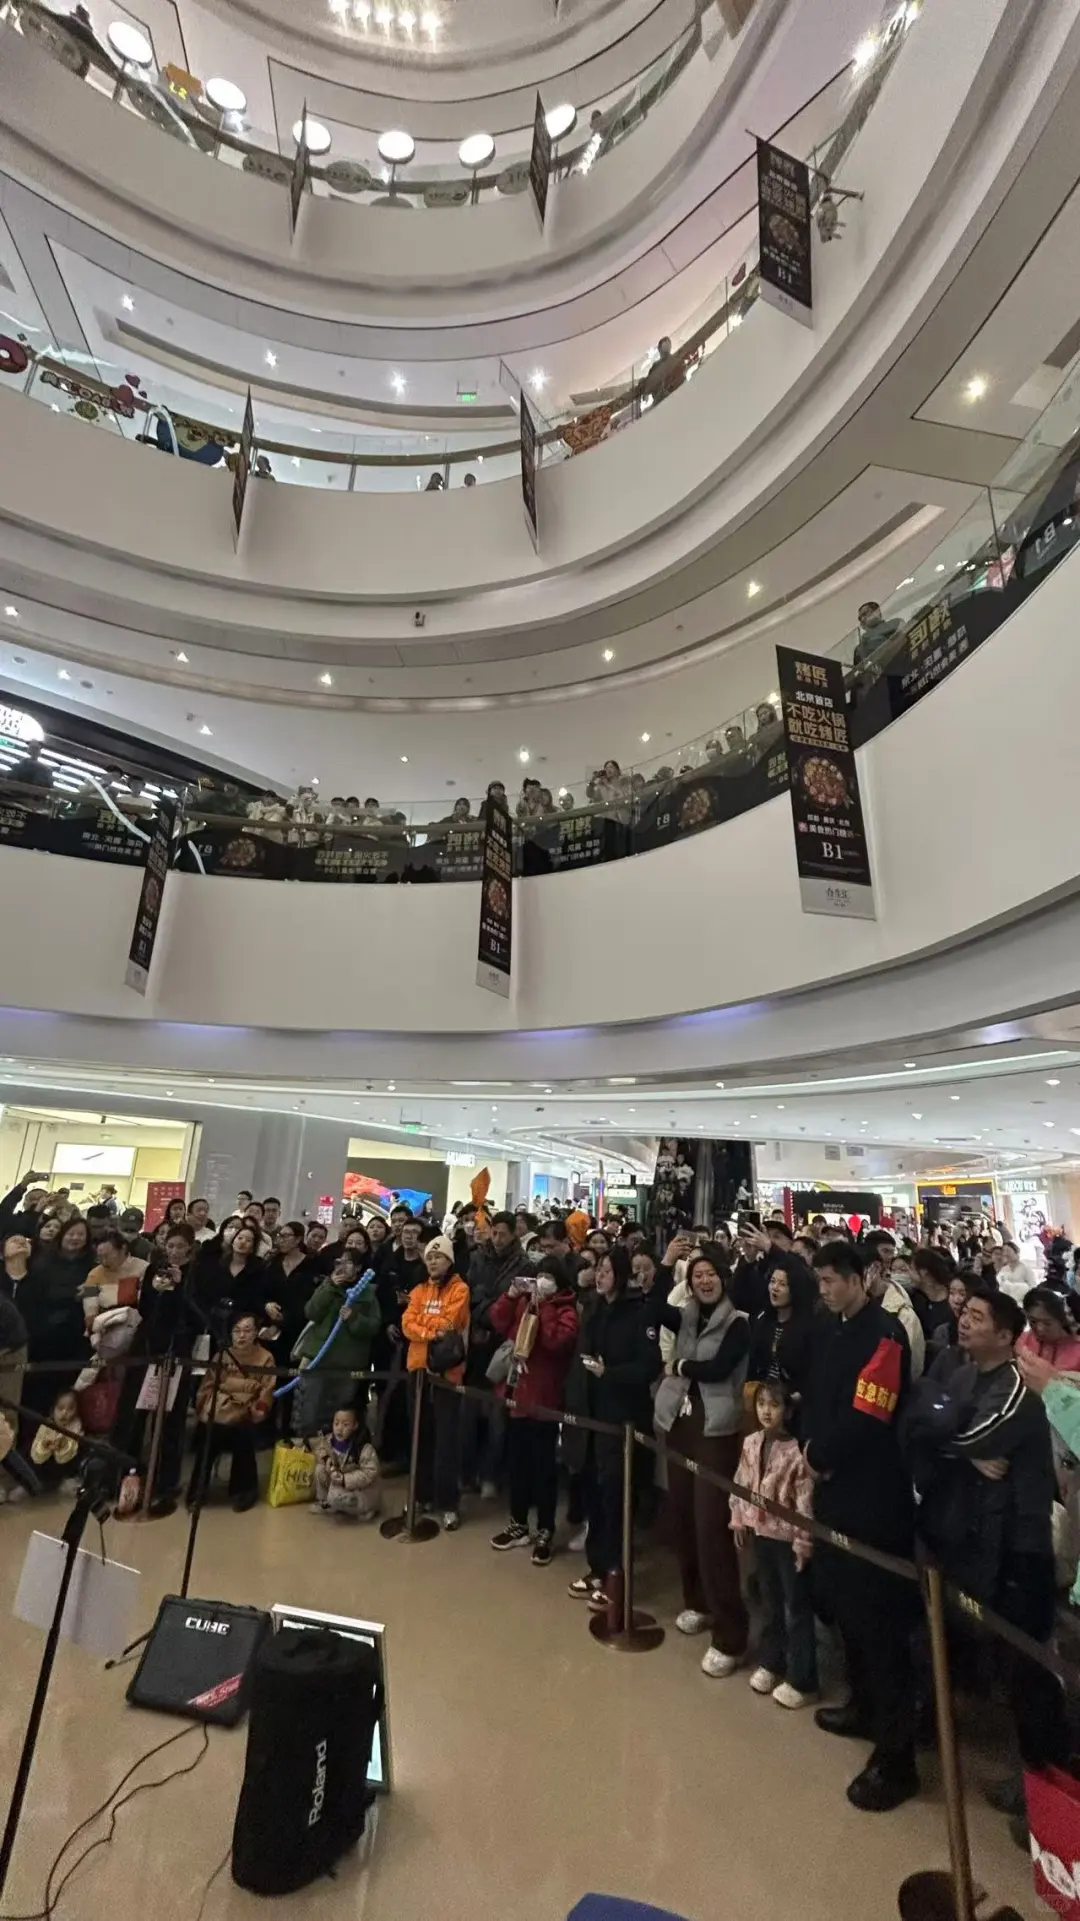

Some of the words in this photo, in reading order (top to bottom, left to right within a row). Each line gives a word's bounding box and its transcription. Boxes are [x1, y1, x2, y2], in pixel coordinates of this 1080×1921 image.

[796, 690, 834, 708] 北京首店
[786, 702, 847, 729] 不吃火锅
[787, 717, 849, 745] 就吃烤匠
[821, 842, 845, 860] B1
[185, 1616, 230, 1636] CUBE
[308, 1739, 328, 1827] Roland
